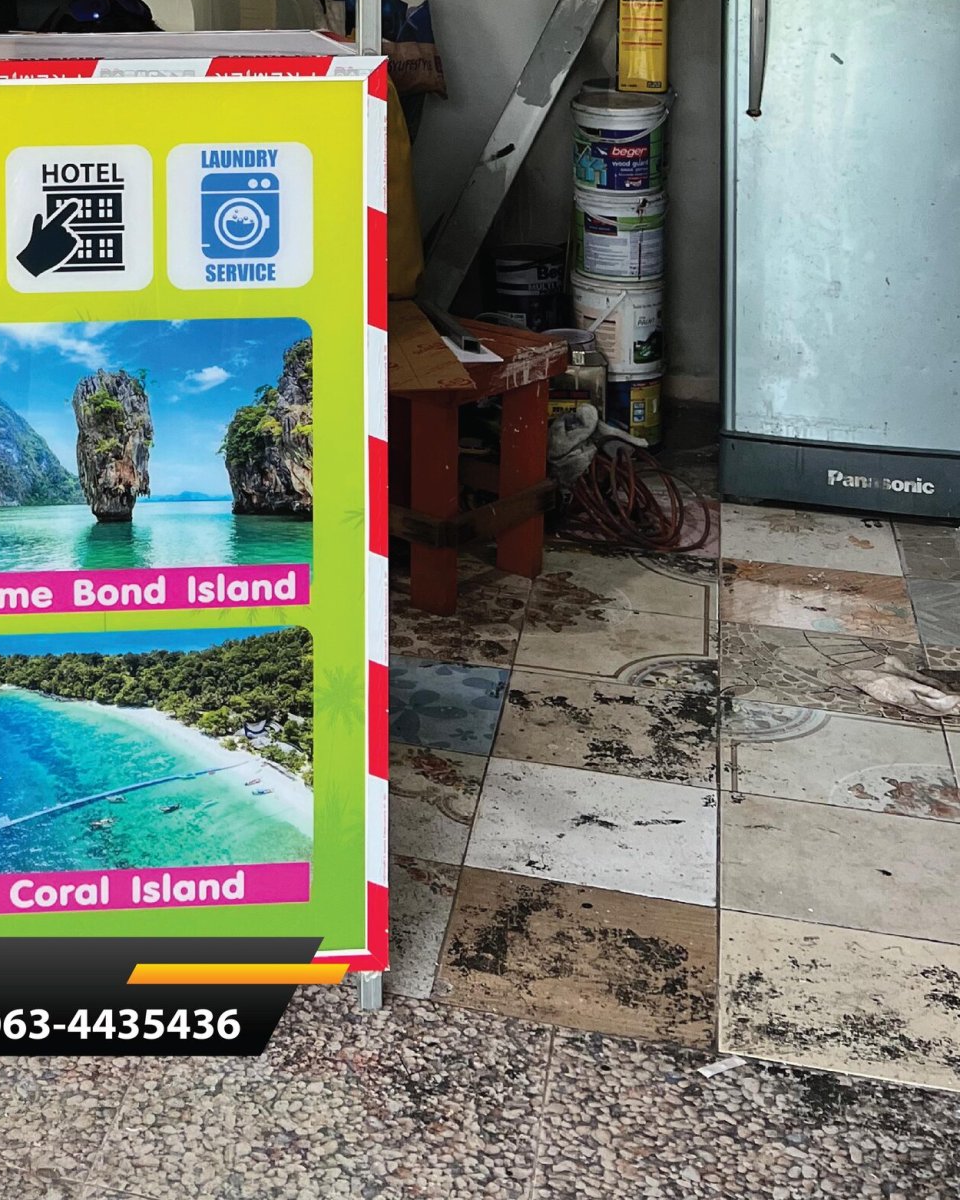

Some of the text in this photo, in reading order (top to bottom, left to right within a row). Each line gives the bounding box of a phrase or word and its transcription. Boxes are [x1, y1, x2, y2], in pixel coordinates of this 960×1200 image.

[201, 149, 278, 169] LAUNDRY
[611, 146, 648, 158] beger
[42, 162, 125, 184] HOTEL
[205, 262, 277, 283] SERVICE
[73, 575, 166, 607] Bond
[188, 570, 296, 603] Island
[9, 869, 245, 908] Coral Island
